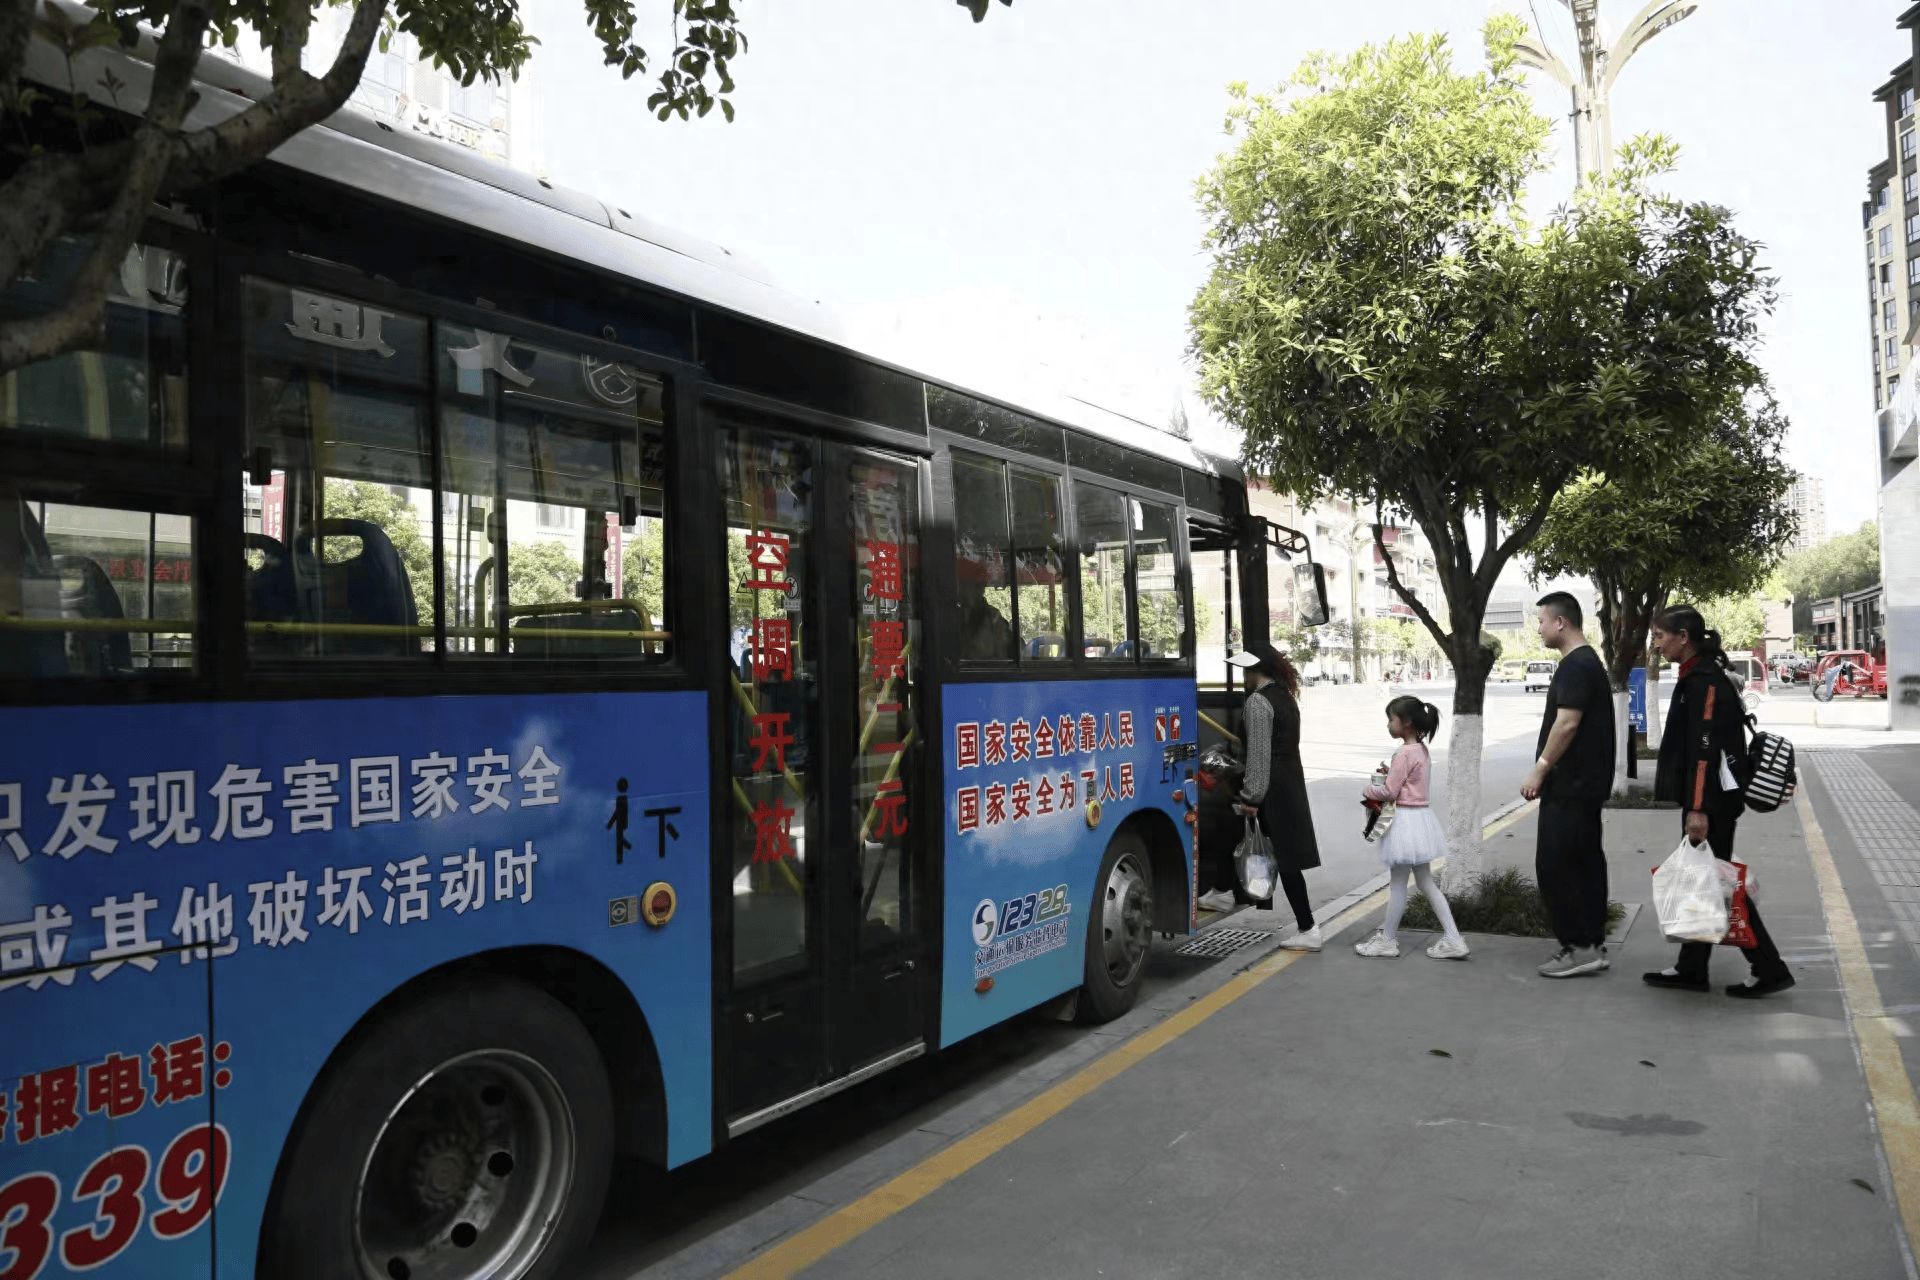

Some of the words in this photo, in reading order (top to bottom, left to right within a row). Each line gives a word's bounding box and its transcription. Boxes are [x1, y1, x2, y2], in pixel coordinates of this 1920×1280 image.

[745, 528, 795, 864] 空调开放
[866, 540, 908, 840] 通票二元
[955, 710, 1135, 770] 国家安全依靠人民
[644, 806, 682, 859] 下
[0, 841, 538, 992] 或其他破坏活动时
[0, 1034, 232, 1144] 报电话：
